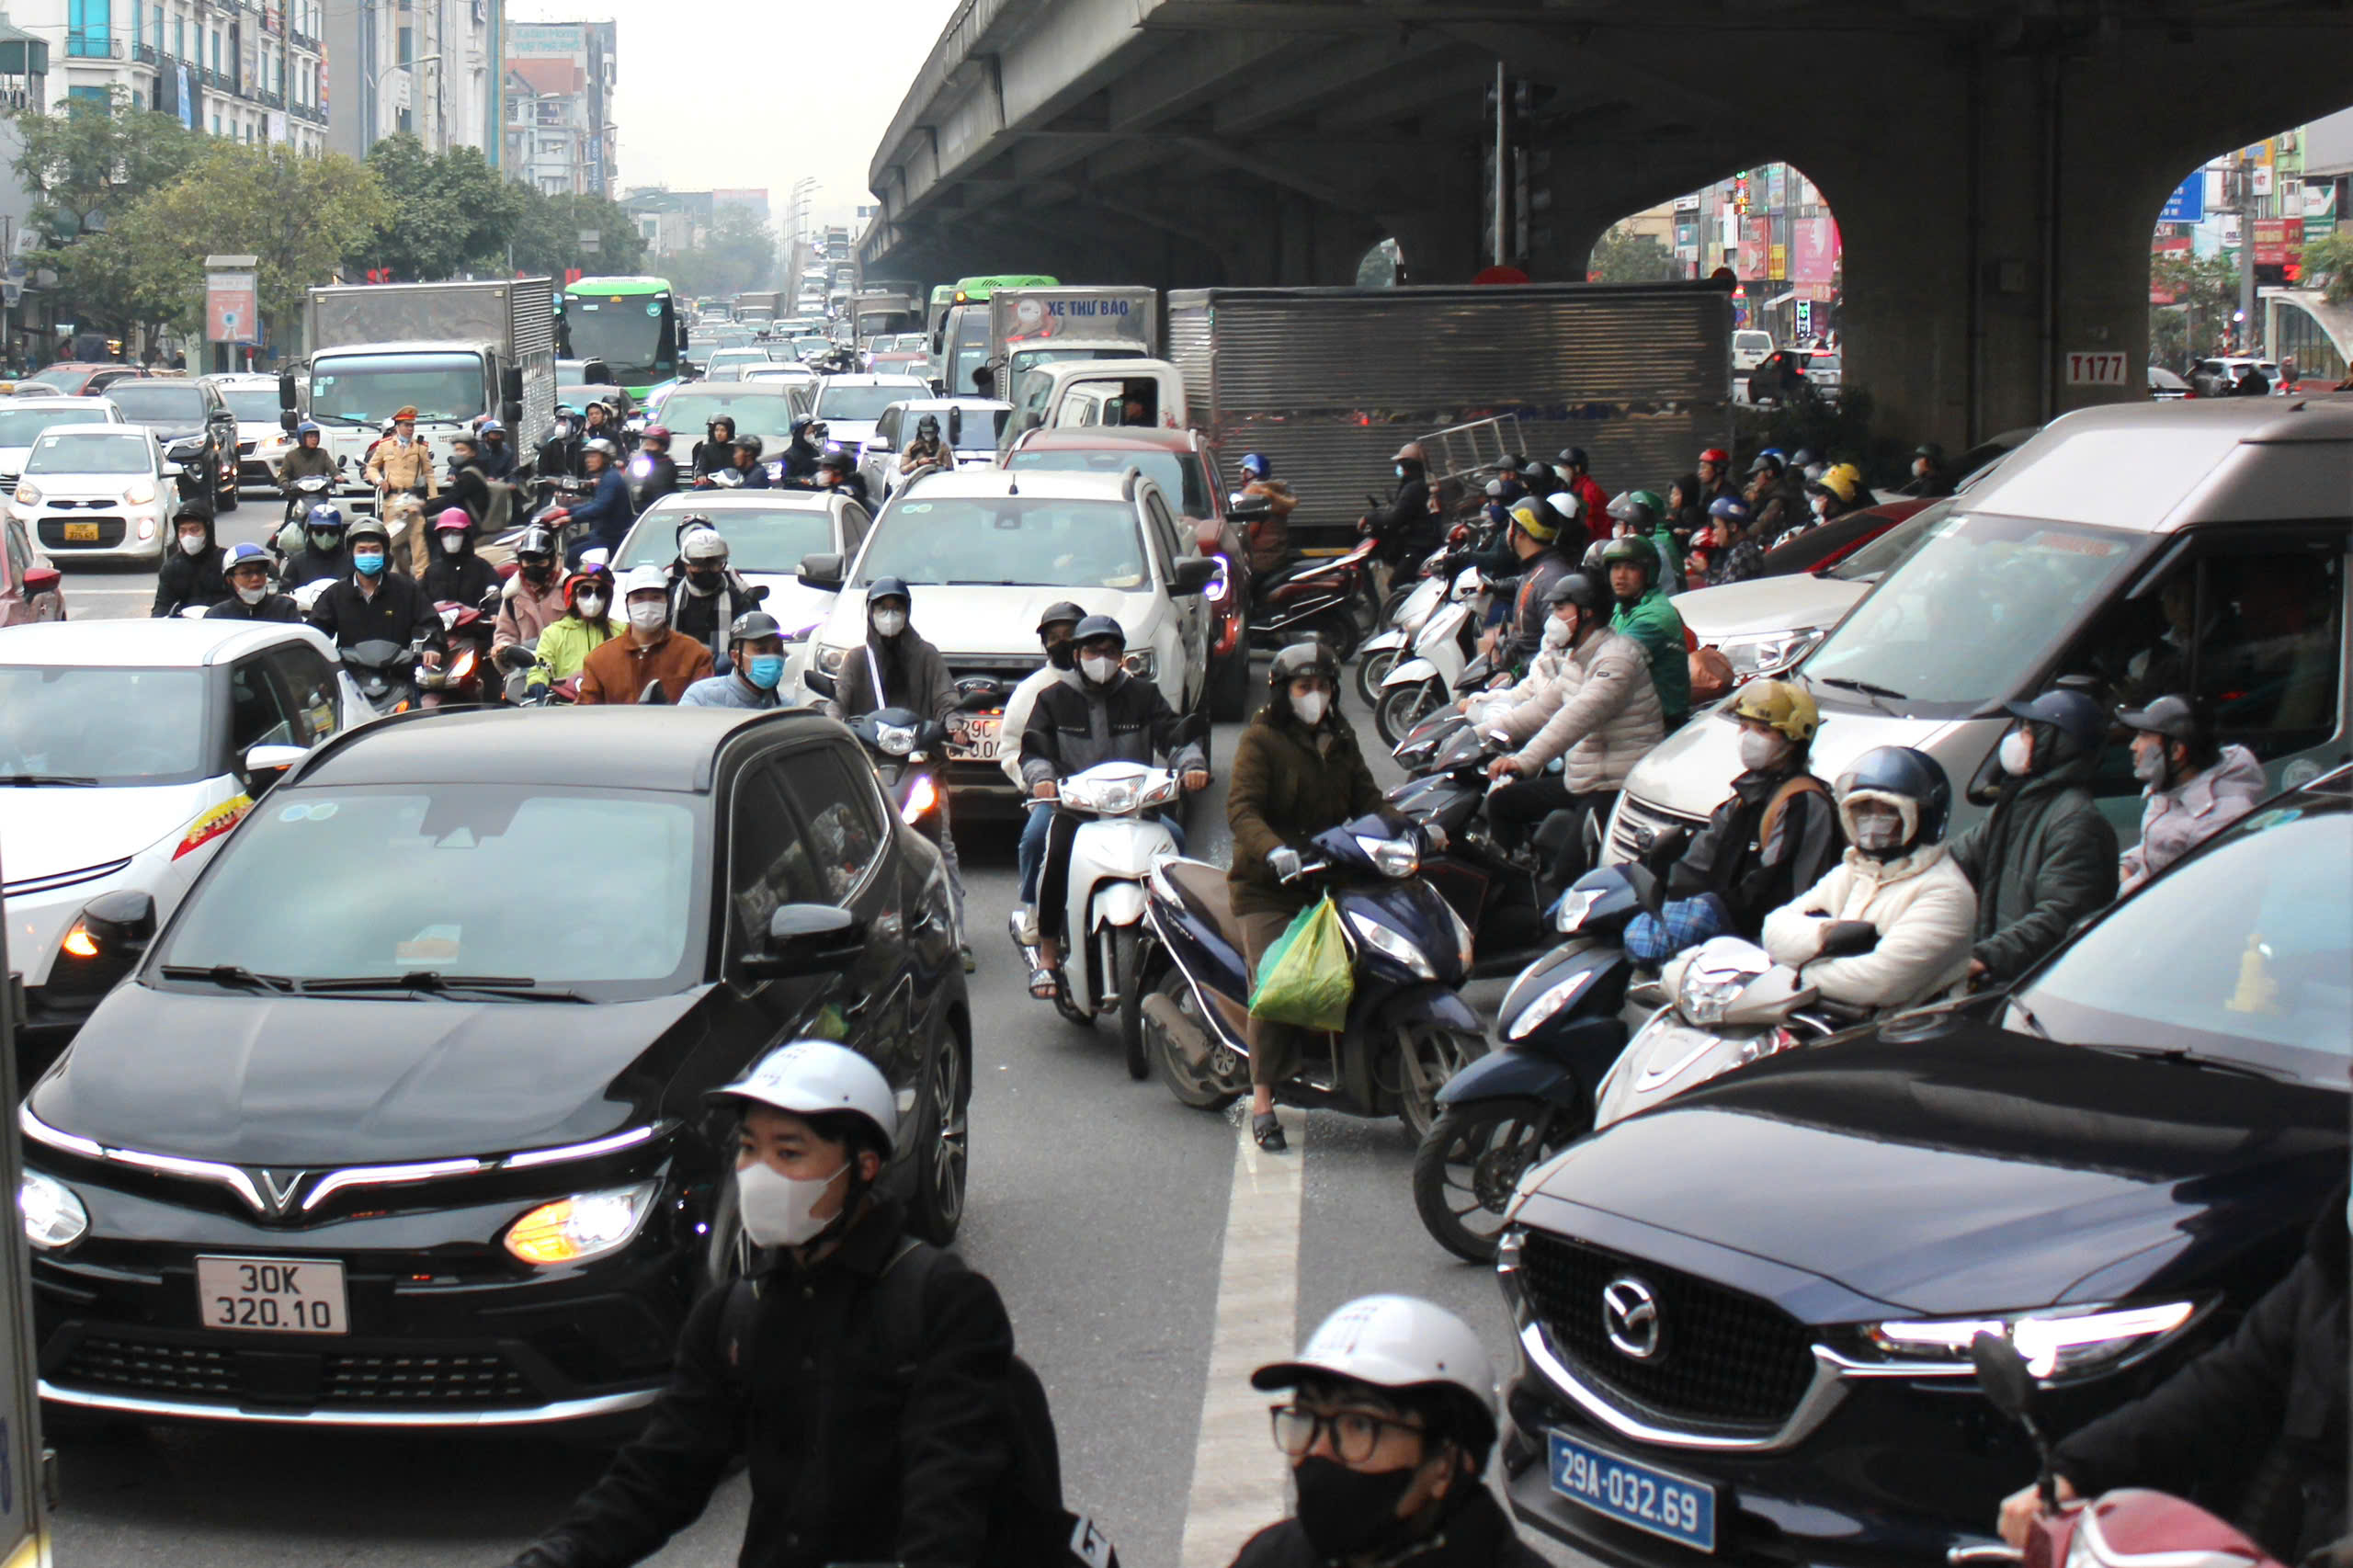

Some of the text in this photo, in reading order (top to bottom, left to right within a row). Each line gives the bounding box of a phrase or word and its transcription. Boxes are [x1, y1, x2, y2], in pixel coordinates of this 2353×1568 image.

[1048, 301, 1065, 316] XE
[1069, 300, 1097, 316] THƯ
[2071, 355, 2122, 381] T177
[239, 1264, 301, 1295] 30K
[216, 1296, 332, 1329] 320.10
[1560, 1447, 1699, 1533] 29A-032.69
